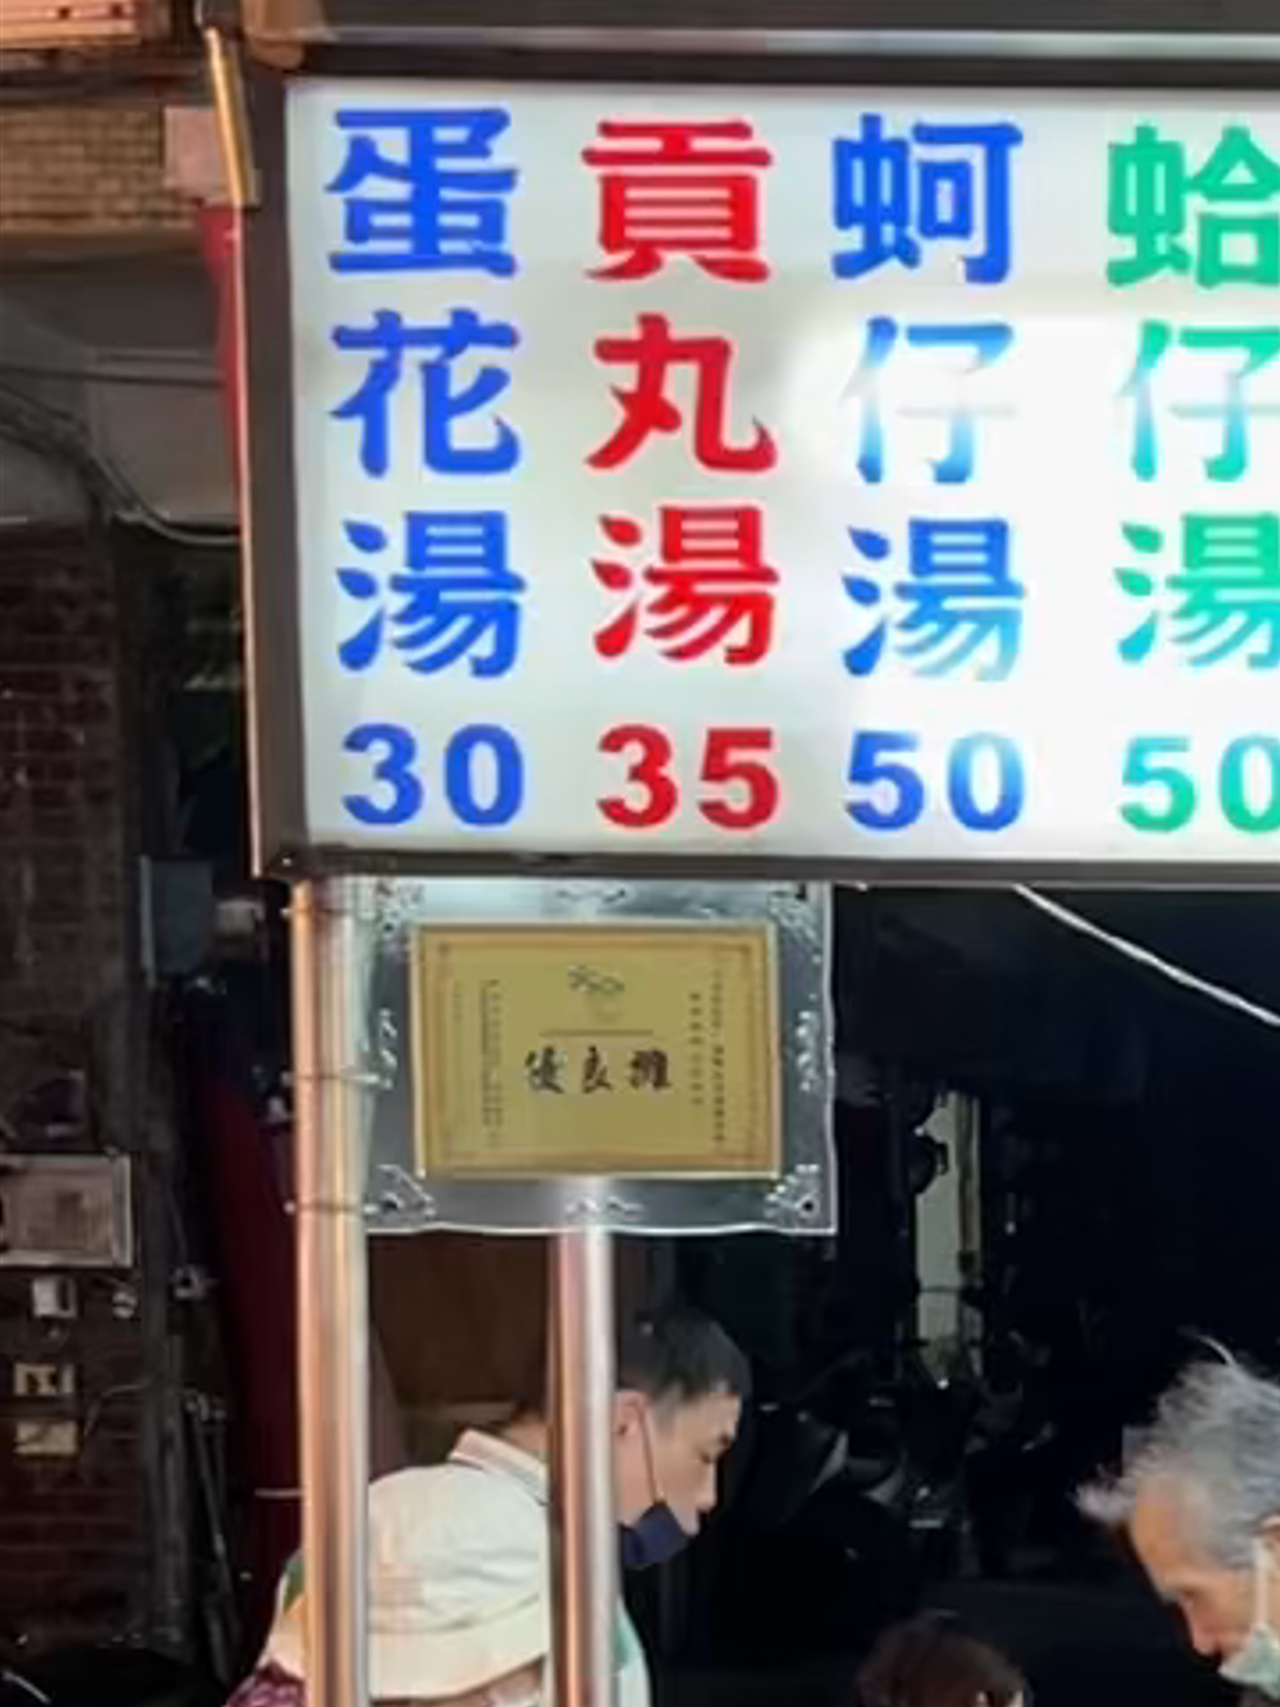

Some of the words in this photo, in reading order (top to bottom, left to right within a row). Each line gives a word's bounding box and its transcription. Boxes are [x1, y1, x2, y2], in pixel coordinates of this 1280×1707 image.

[325, 105, 530, 681] 蛋花湯
[581, 119, 783, 669] 貢丸湯
[830, 111, 1028, 681] 蚵仔湯
[341, 721, 528, 831] 30
[597, 723, 783, 833] 35
[845, 729, 1027, 836] 50
